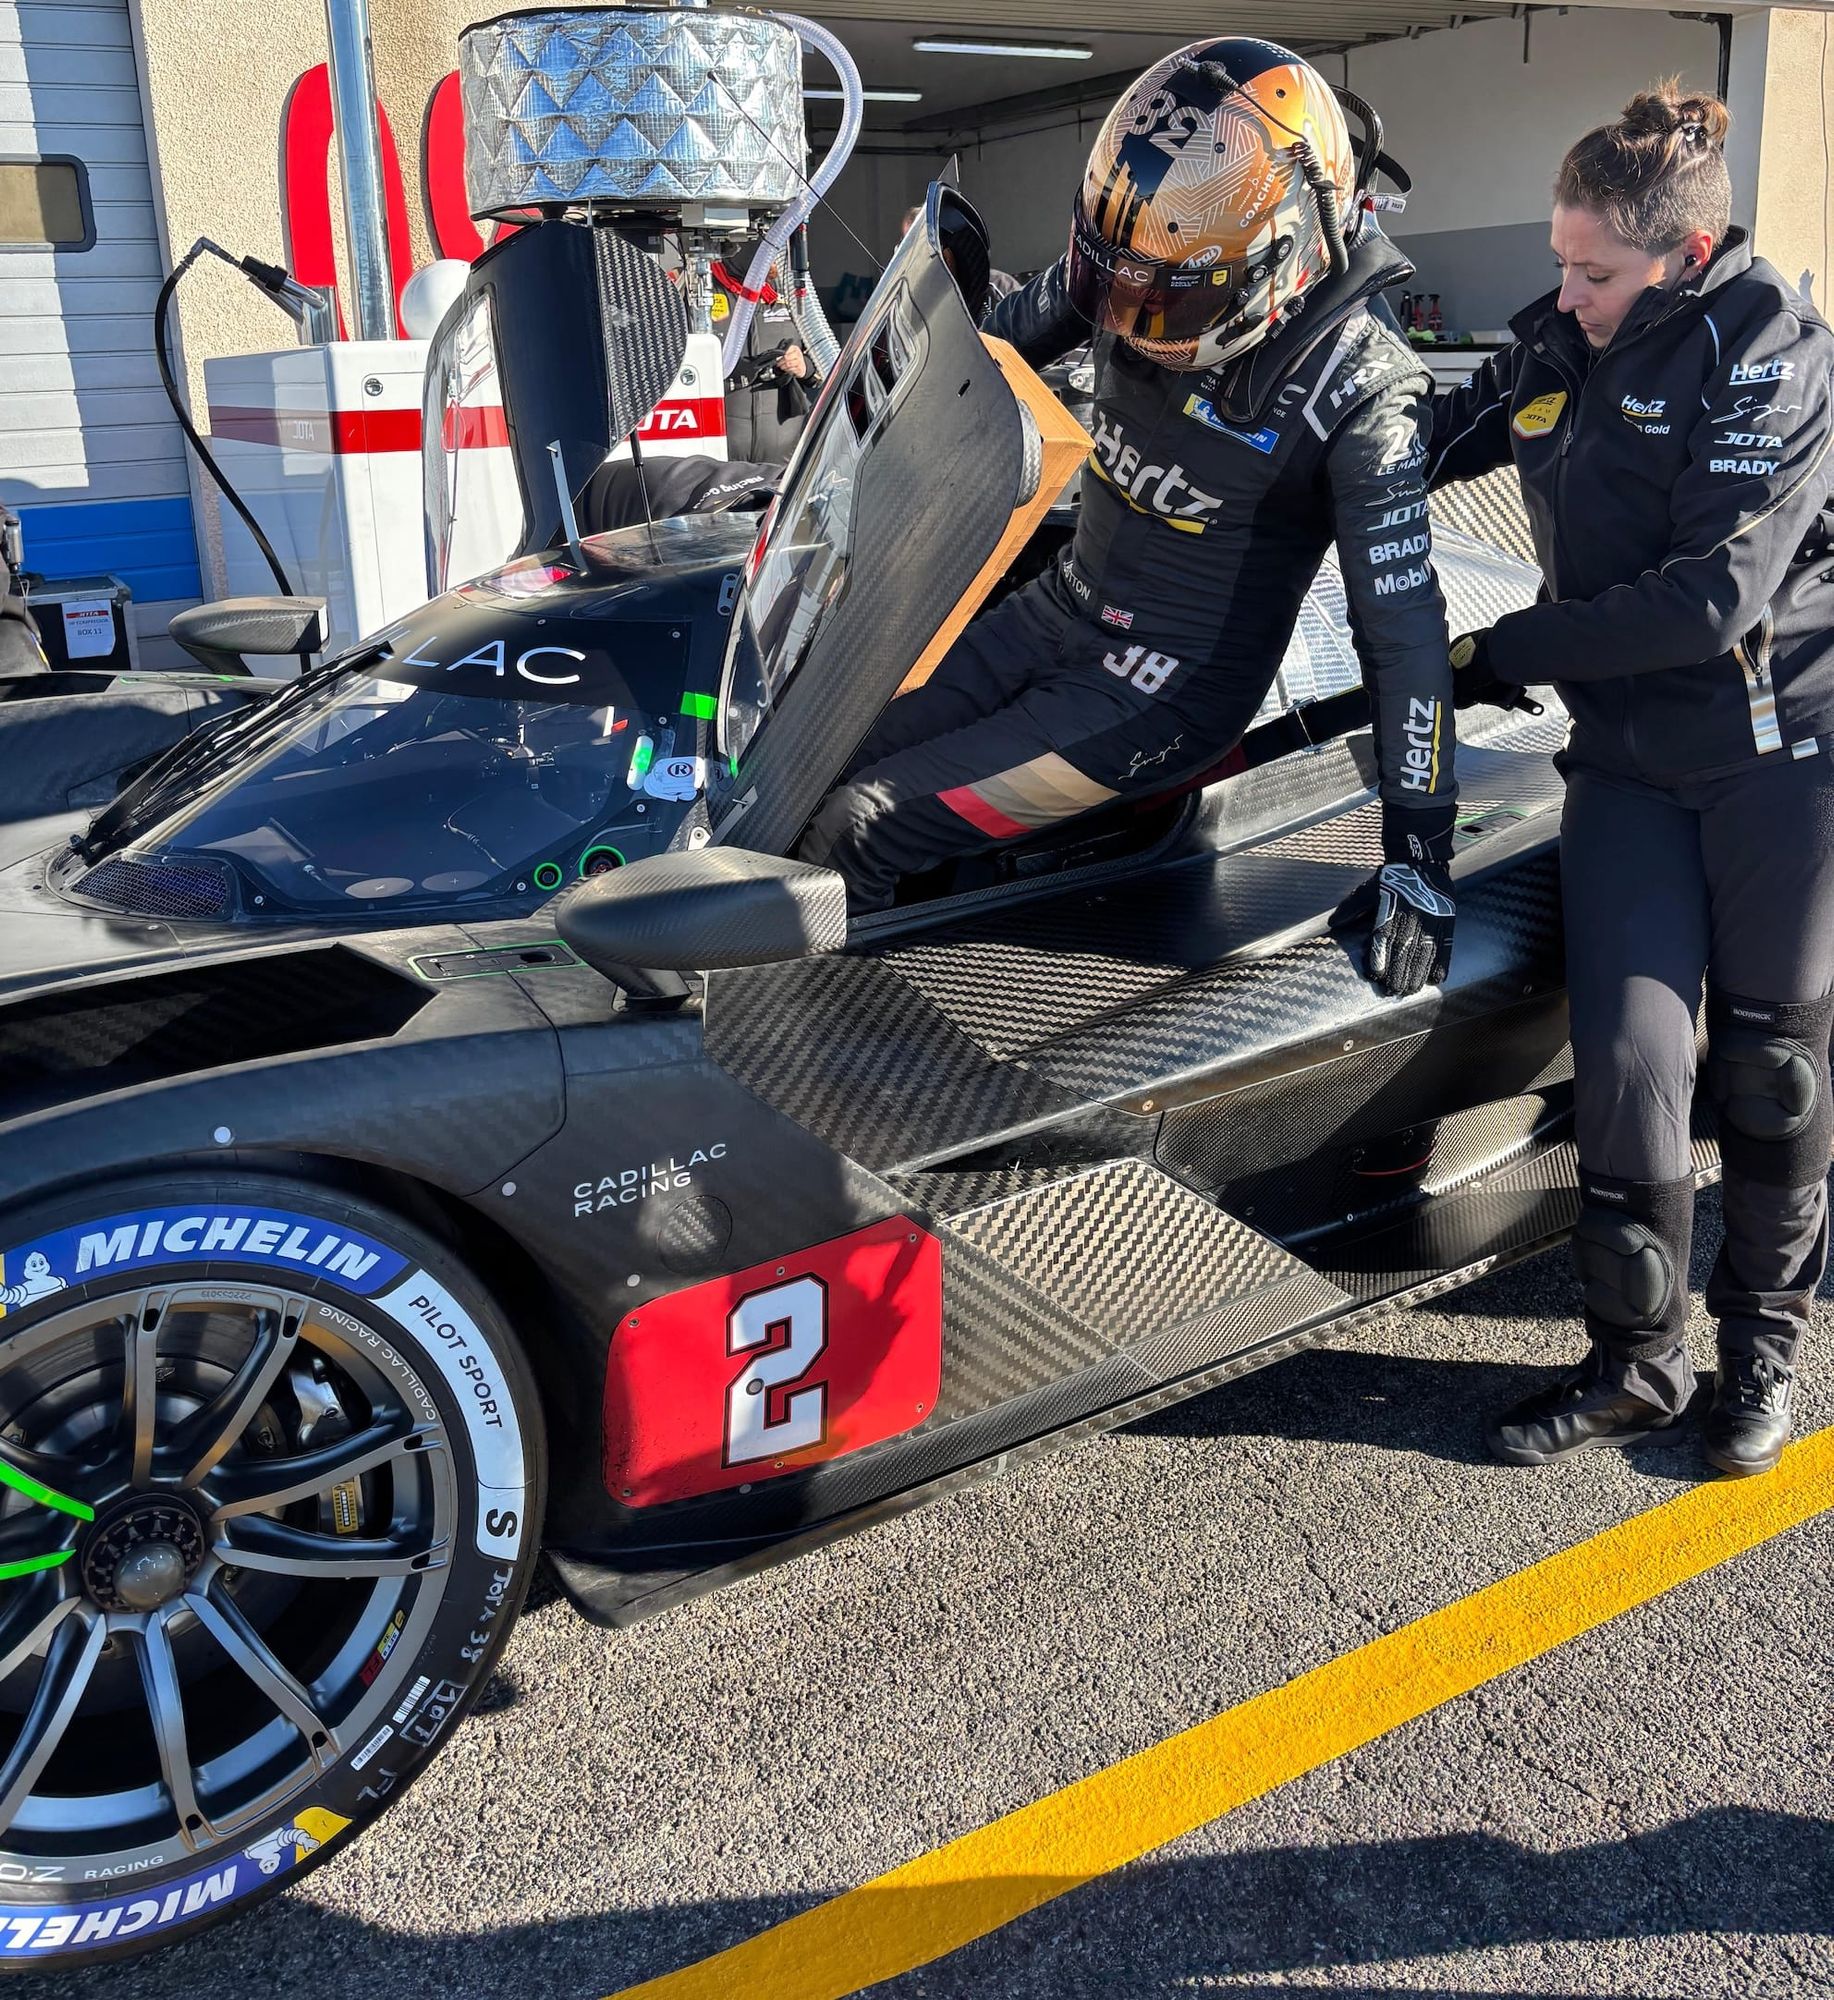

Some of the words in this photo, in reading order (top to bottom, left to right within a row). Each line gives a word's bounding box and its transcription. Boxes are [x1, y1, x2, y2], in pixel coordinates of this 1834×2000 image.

[1073, 233, 1150, 284] ADILLAC
[1730, 360, 1795, 381] Hertz
[292, 420, 315, 441] JOTA
[1644, 425, 1671, 435] Gold
[1714, 432, 1783, 448] JOTA
[1092, 410, 1224, 523] Hertz
[1377, 464, 1396, 477] LE
[1709, 459, 1780, 476] BRADY
[1366, 500, 1429, 532] JOTA
[1368, 531, 1430, 565] BRADY
[1400, 696, 1436, 793] Hertz
[573, 1143, 727, 1198] CADILLAC
[574, 1171, 692, 1217] RACING
[75, 1217, 381, 1281] MICHELIN
[318, 1306, 381, 1348] RACING
[408, 1295, 468, 1350] PILOT
[458, 1355, 503, 1428] SPORT
[722, 1272, 829, 1469] 2
[381, 1349, 437, 1421] CADILLAC
[486, 1508, 518, 1539] S
[83, 1854, 165, 1880] RACING
[0, 1865, 238, 1949] MICHEL
